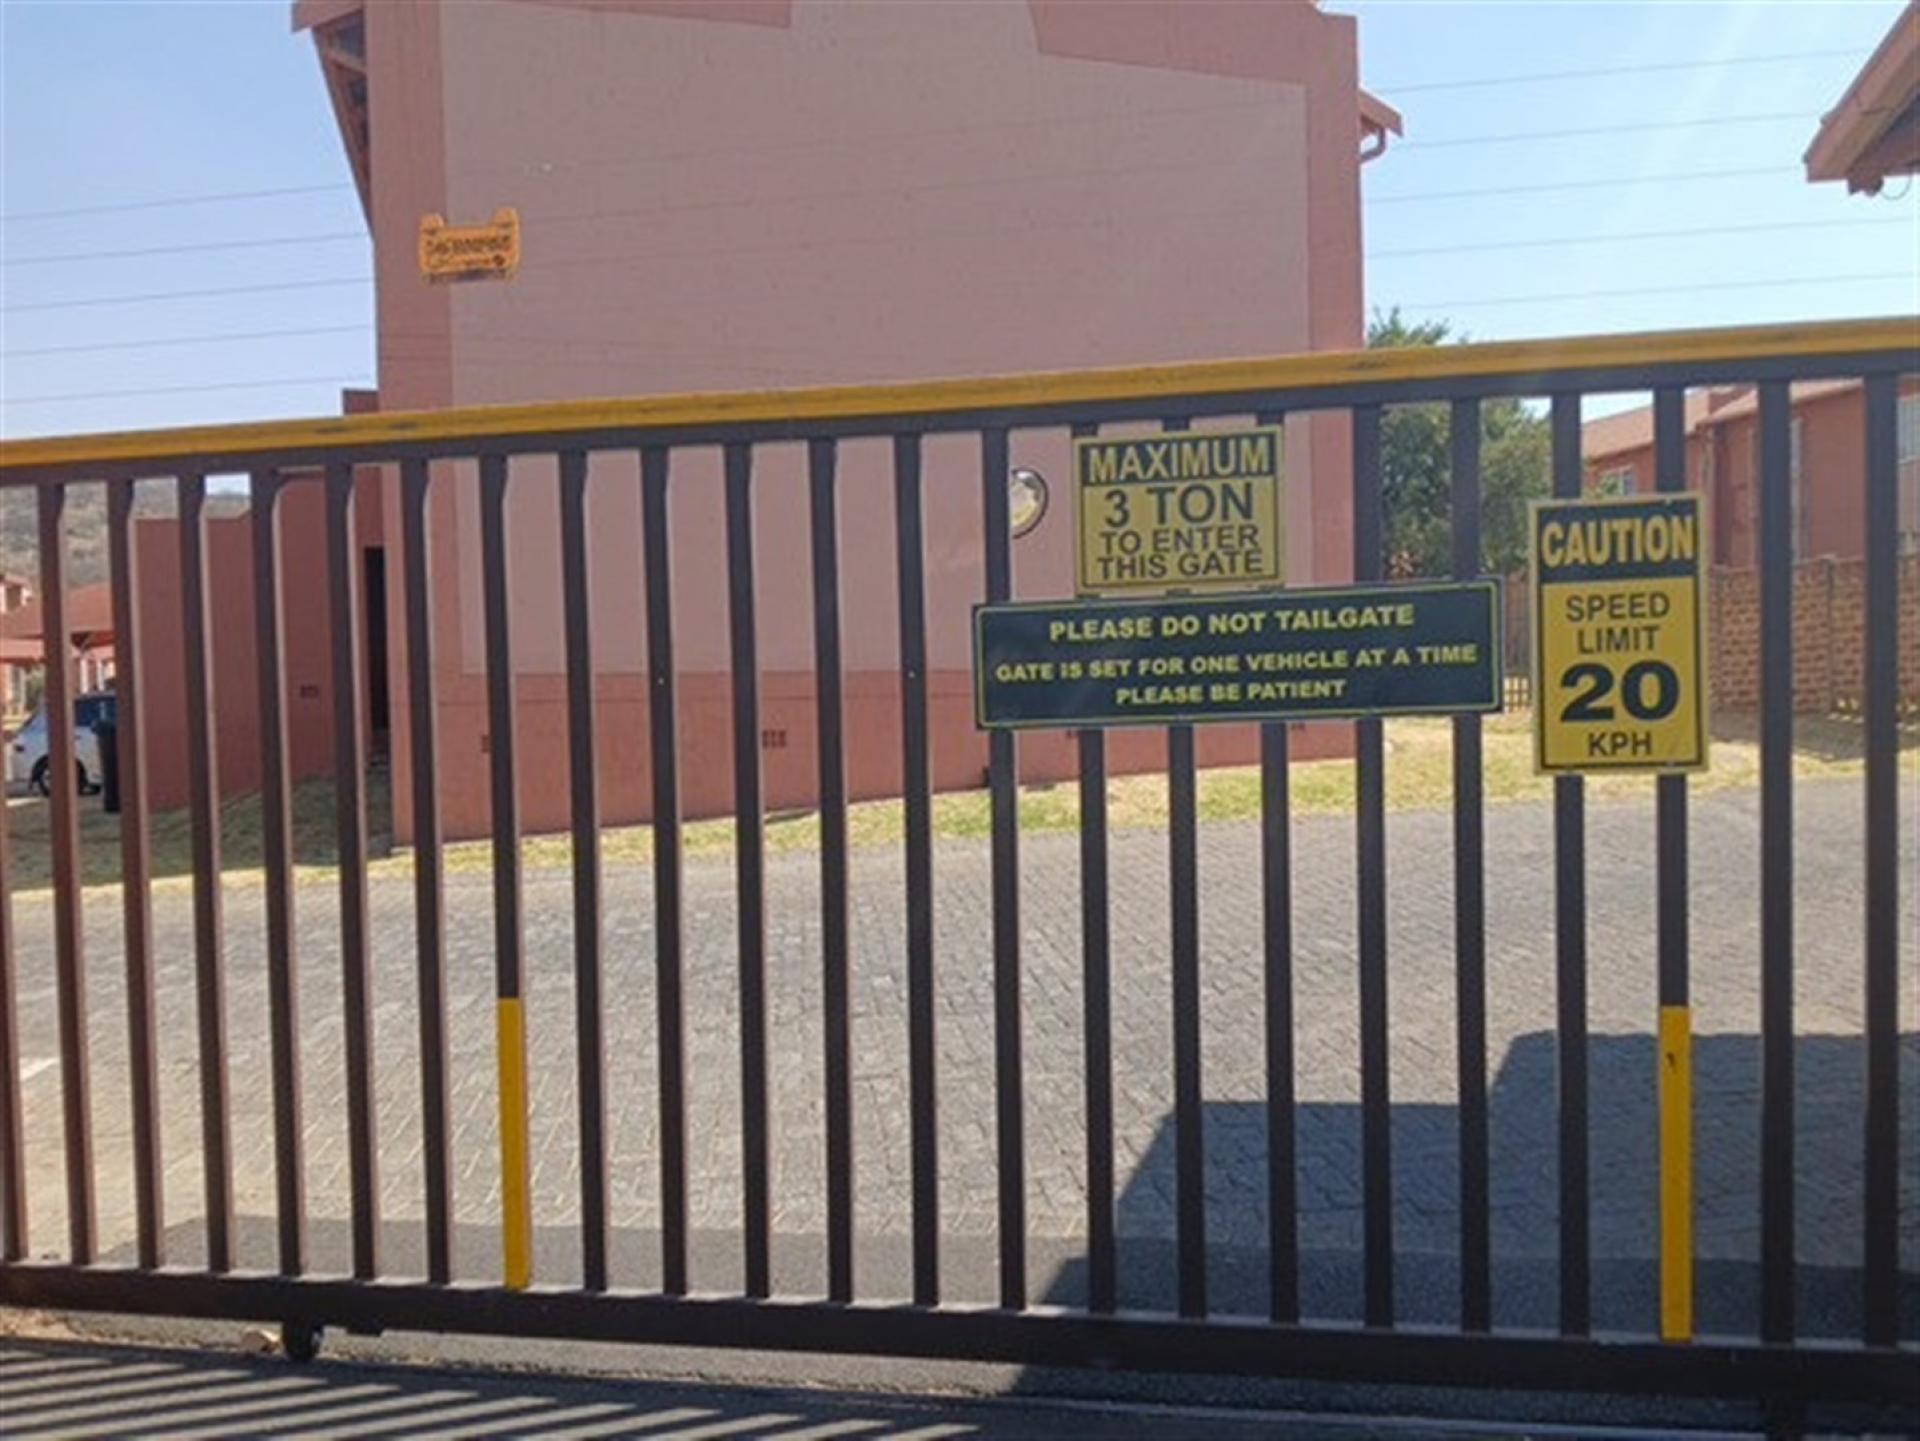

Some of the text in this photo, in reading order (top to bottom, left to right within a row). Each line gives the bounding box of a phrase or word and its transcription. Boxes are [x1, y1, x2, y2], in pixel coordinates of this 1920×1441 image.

[1089, 436, 1269, 483] MAXIMUM
[1105, 483, 1253, 528] 3 TON
[1101, 524, 1259, 555] TO ENTER
[1541, 515, 1694, 568] CAUTION
[1097, 549, 1263, 580] THIS GATE
[1050, 604, 1415, 642] PLEASE DO NOT TAILGATE
[1565, 592, 1670, 622] SPEED
[1577, 626, 1660, 655] LIMIT
[996, 644, 1478, 683] GATE IS SET FOR ONE VEHICLE AT A TIME
[1116, 679, 1346, 705] PLEASE BE PATIENT
[1560, 660, 1680, 722] 20
[1588, 731, 1652, 757] KPH
